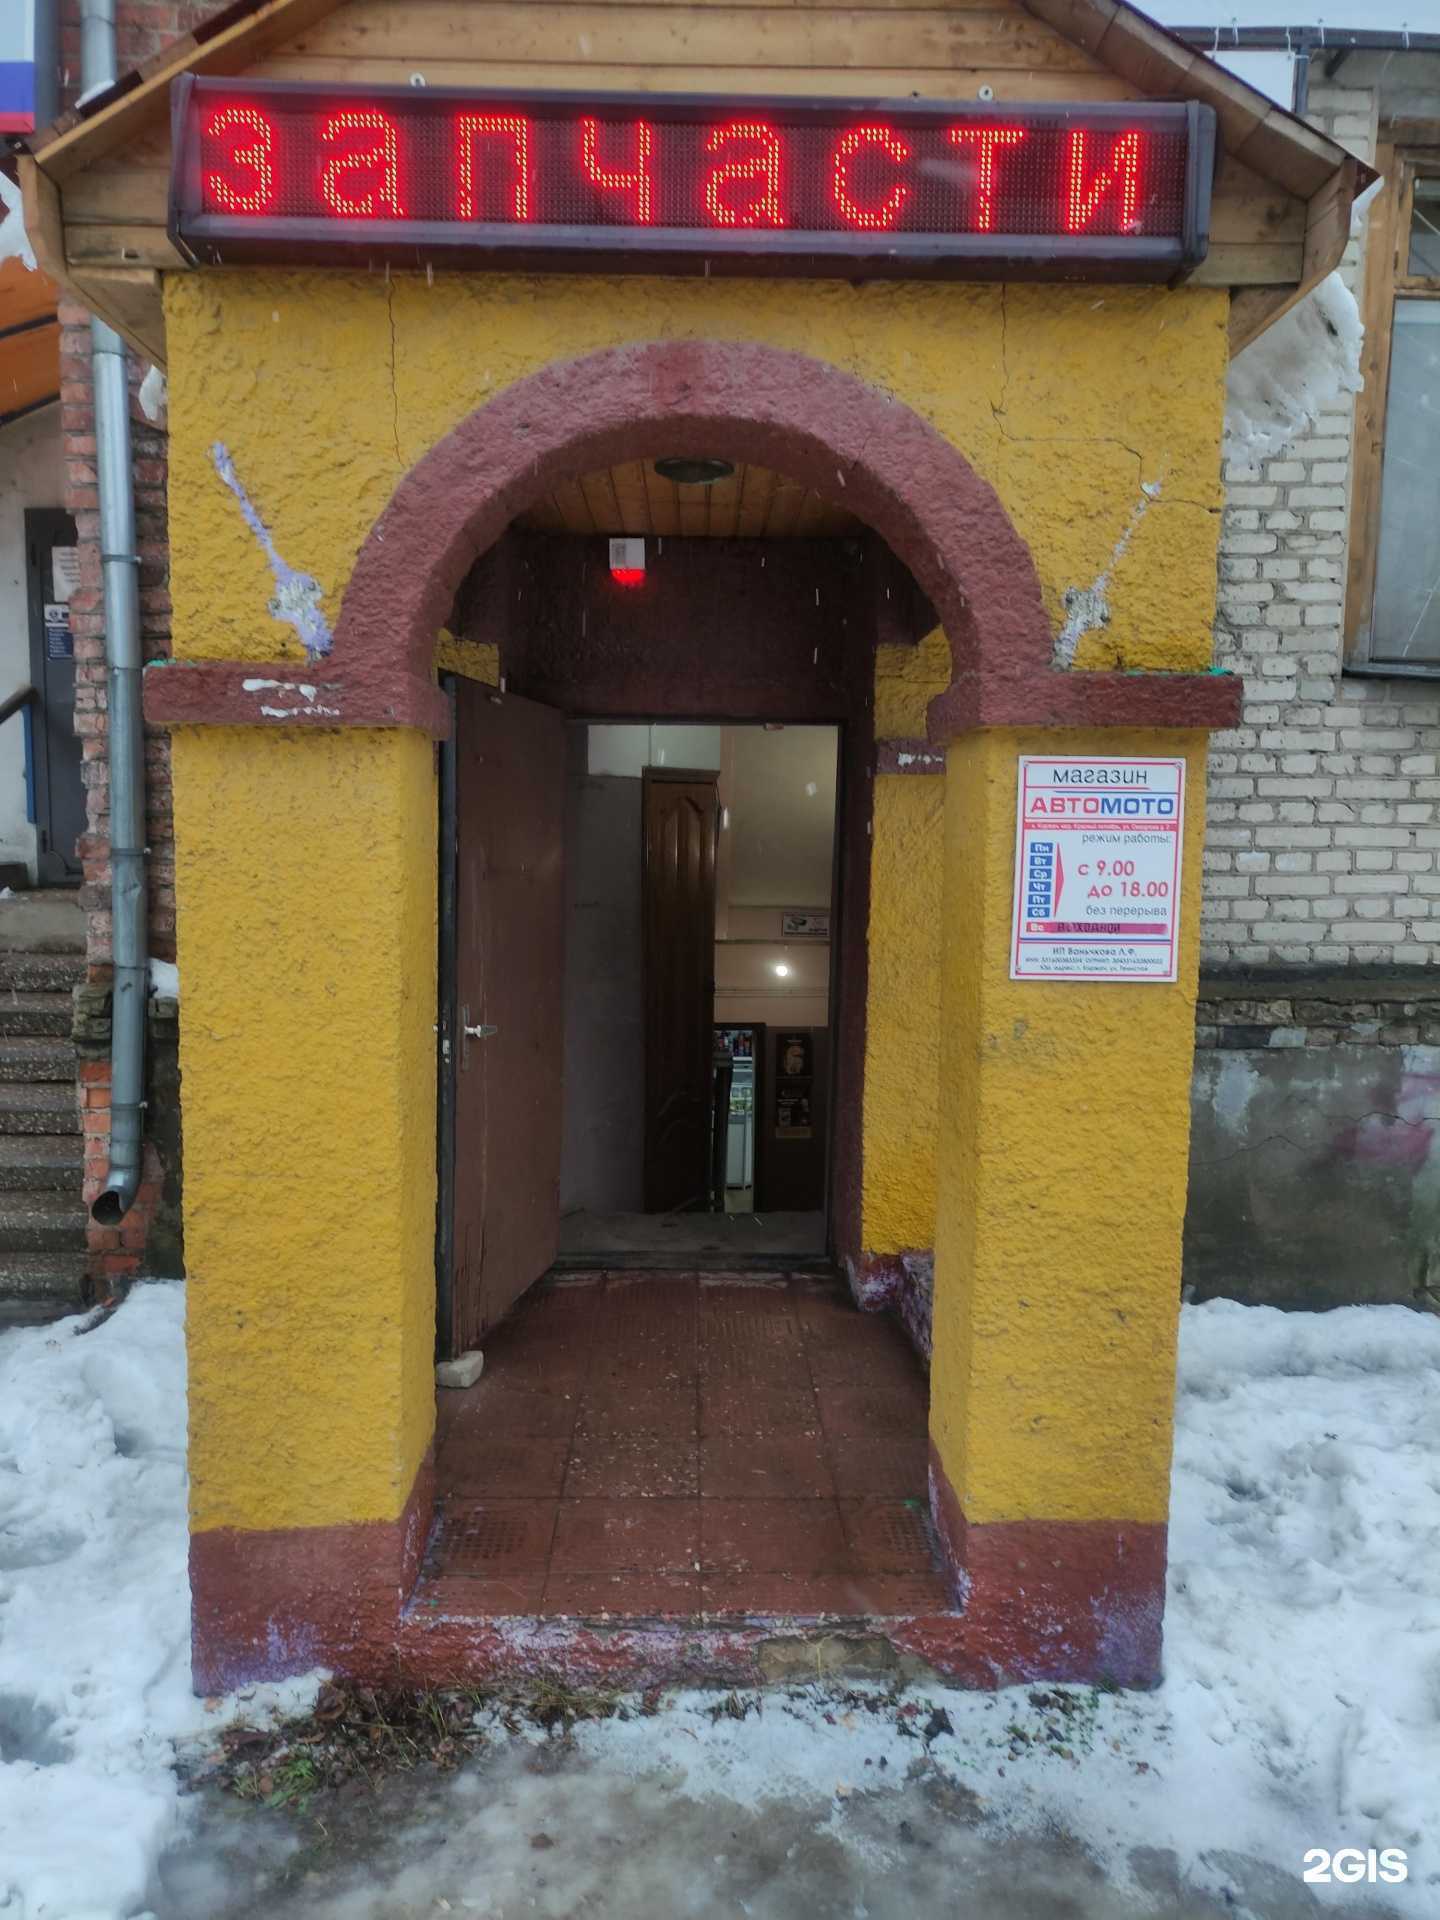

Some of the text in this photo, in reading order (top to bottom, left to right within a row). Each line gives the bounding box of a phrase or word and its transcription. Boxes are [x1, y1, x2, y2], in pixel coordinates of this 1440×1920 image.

[1053, 768, 1148, 785] магазин
[1031, 797, 1174, 815] АВТОМОТО
[1082, 834, 1120, 844] режим
[1097, 860, 1135, 876] 9.00
[1121, 881, 1169, 897] 18.00
[1086, 905, 1168, 917] без перерыва
